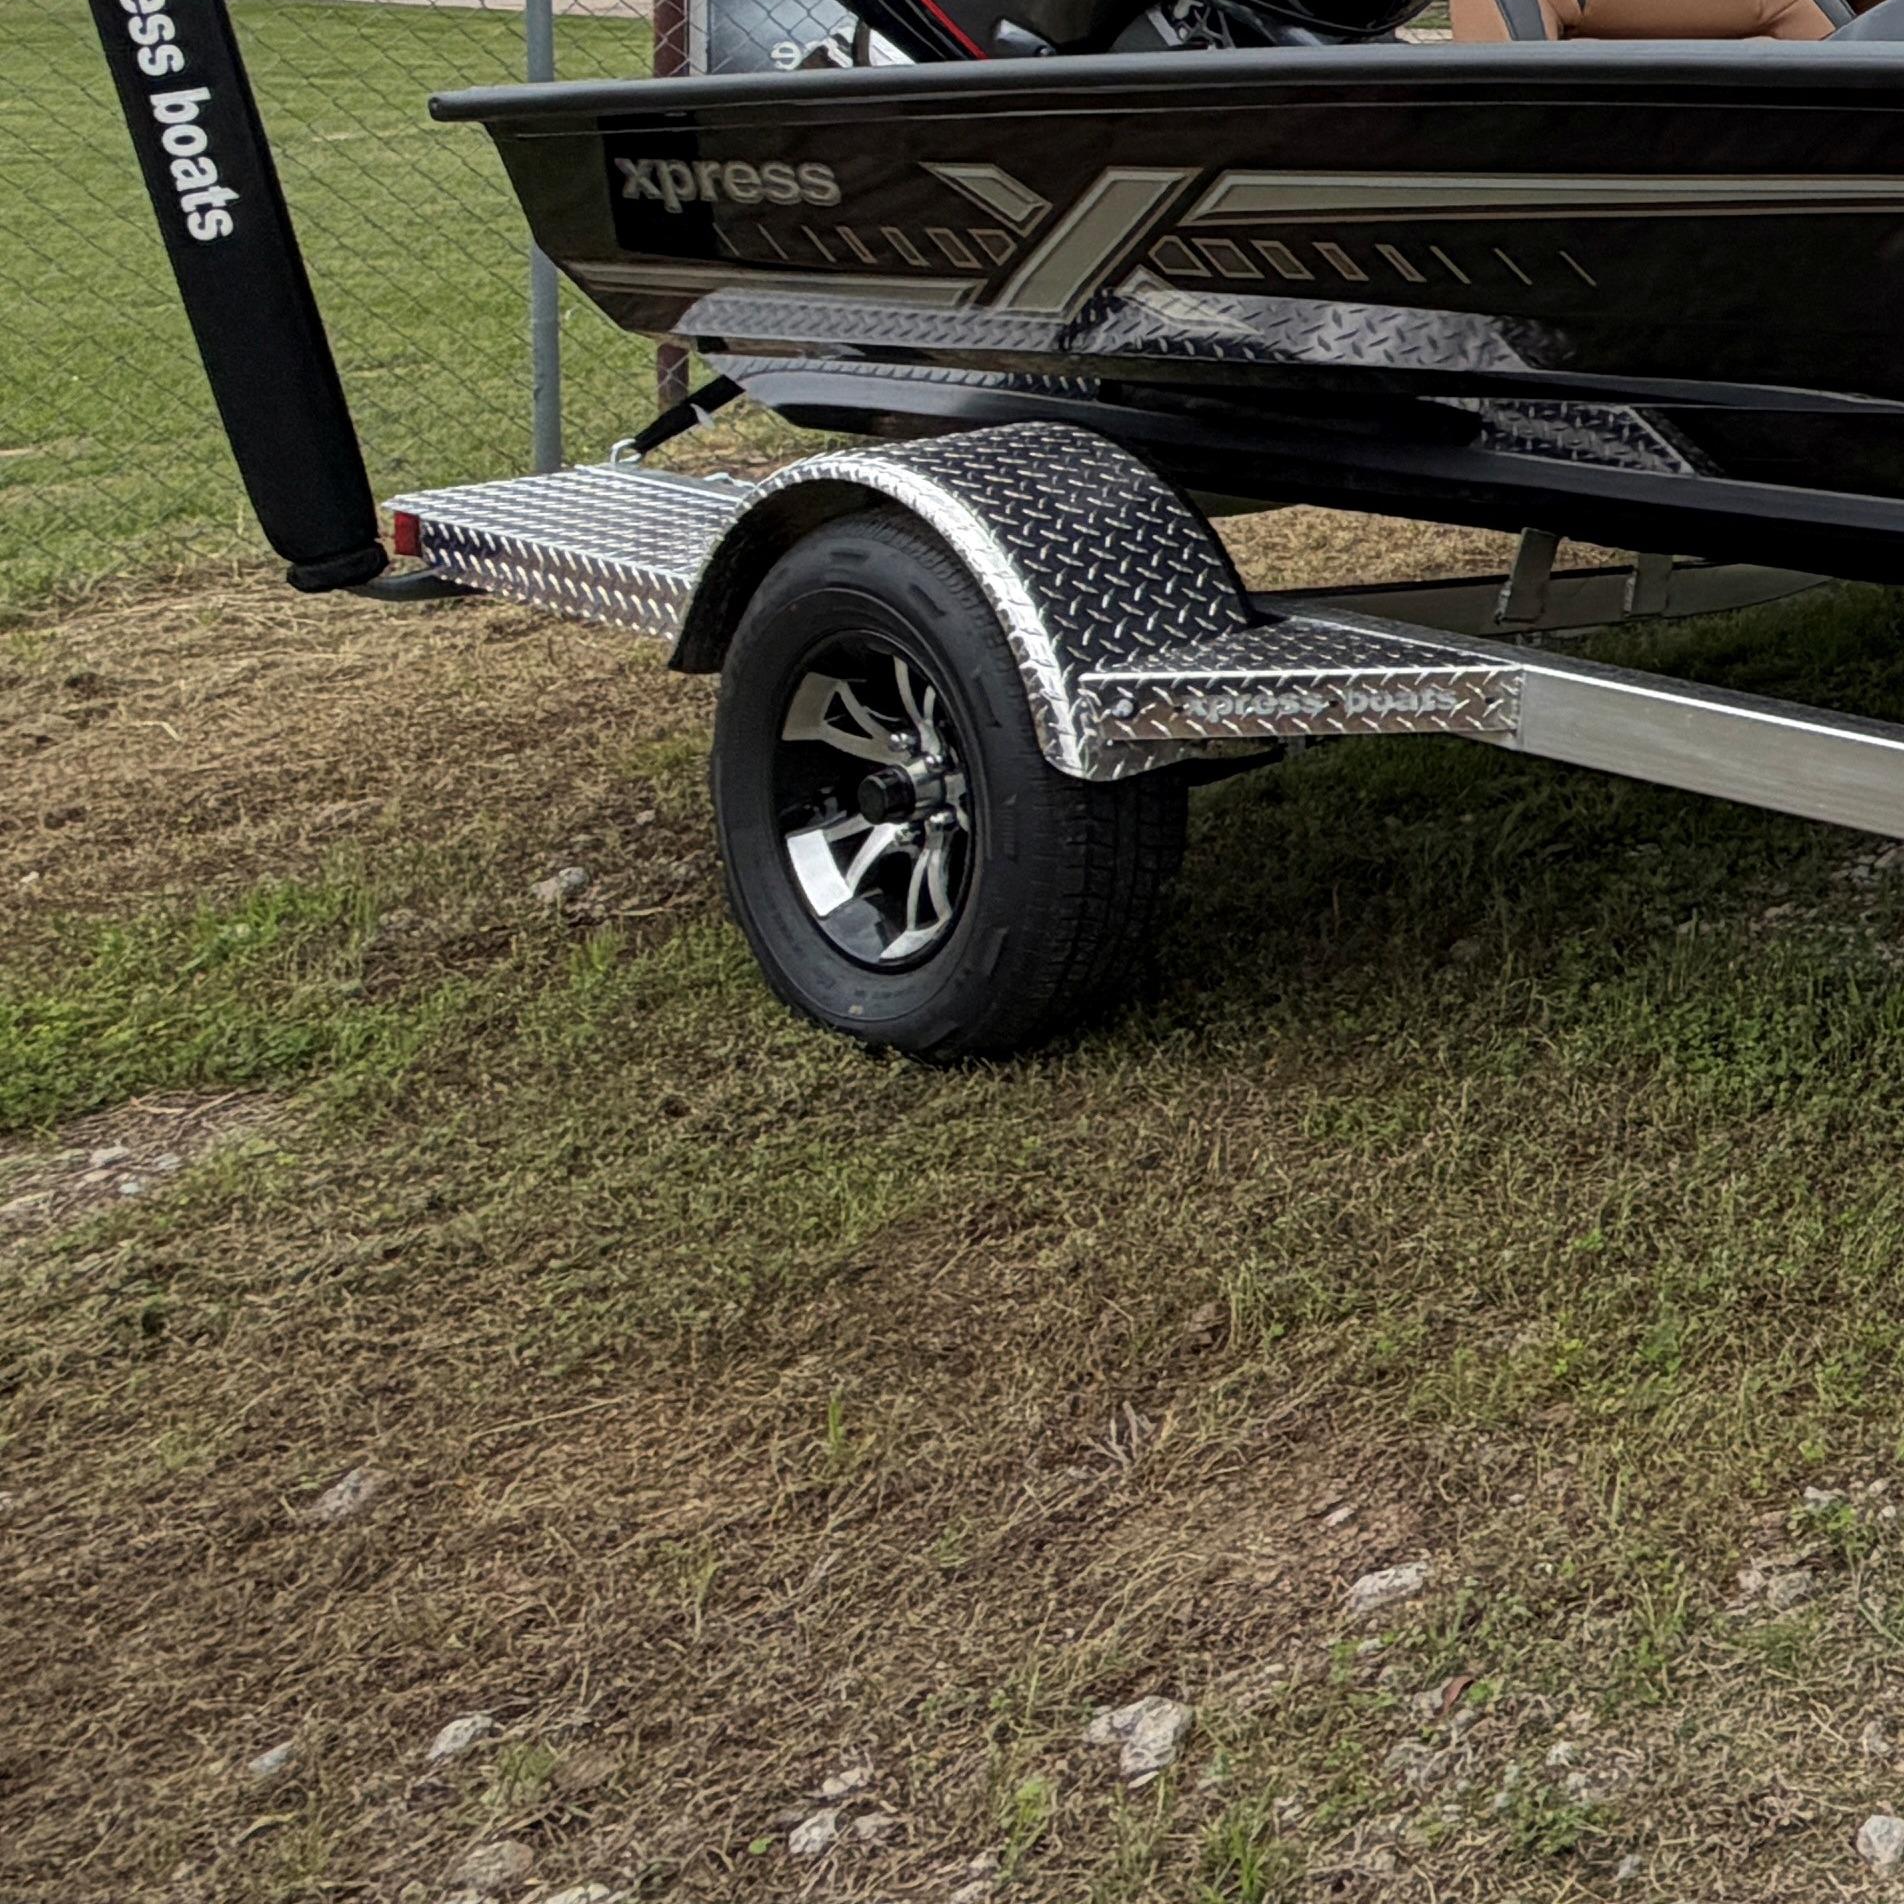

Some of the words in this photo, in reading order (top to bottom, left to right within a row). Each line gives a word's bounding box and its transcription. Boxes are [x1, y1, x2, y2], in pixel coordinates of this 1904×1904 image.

[150, 86, 239, 243] boats
[614, 156, 843, 214] xpress
[1183, 693, 1324, 723] xpress
[1342, 687, 1457, 713] boats
